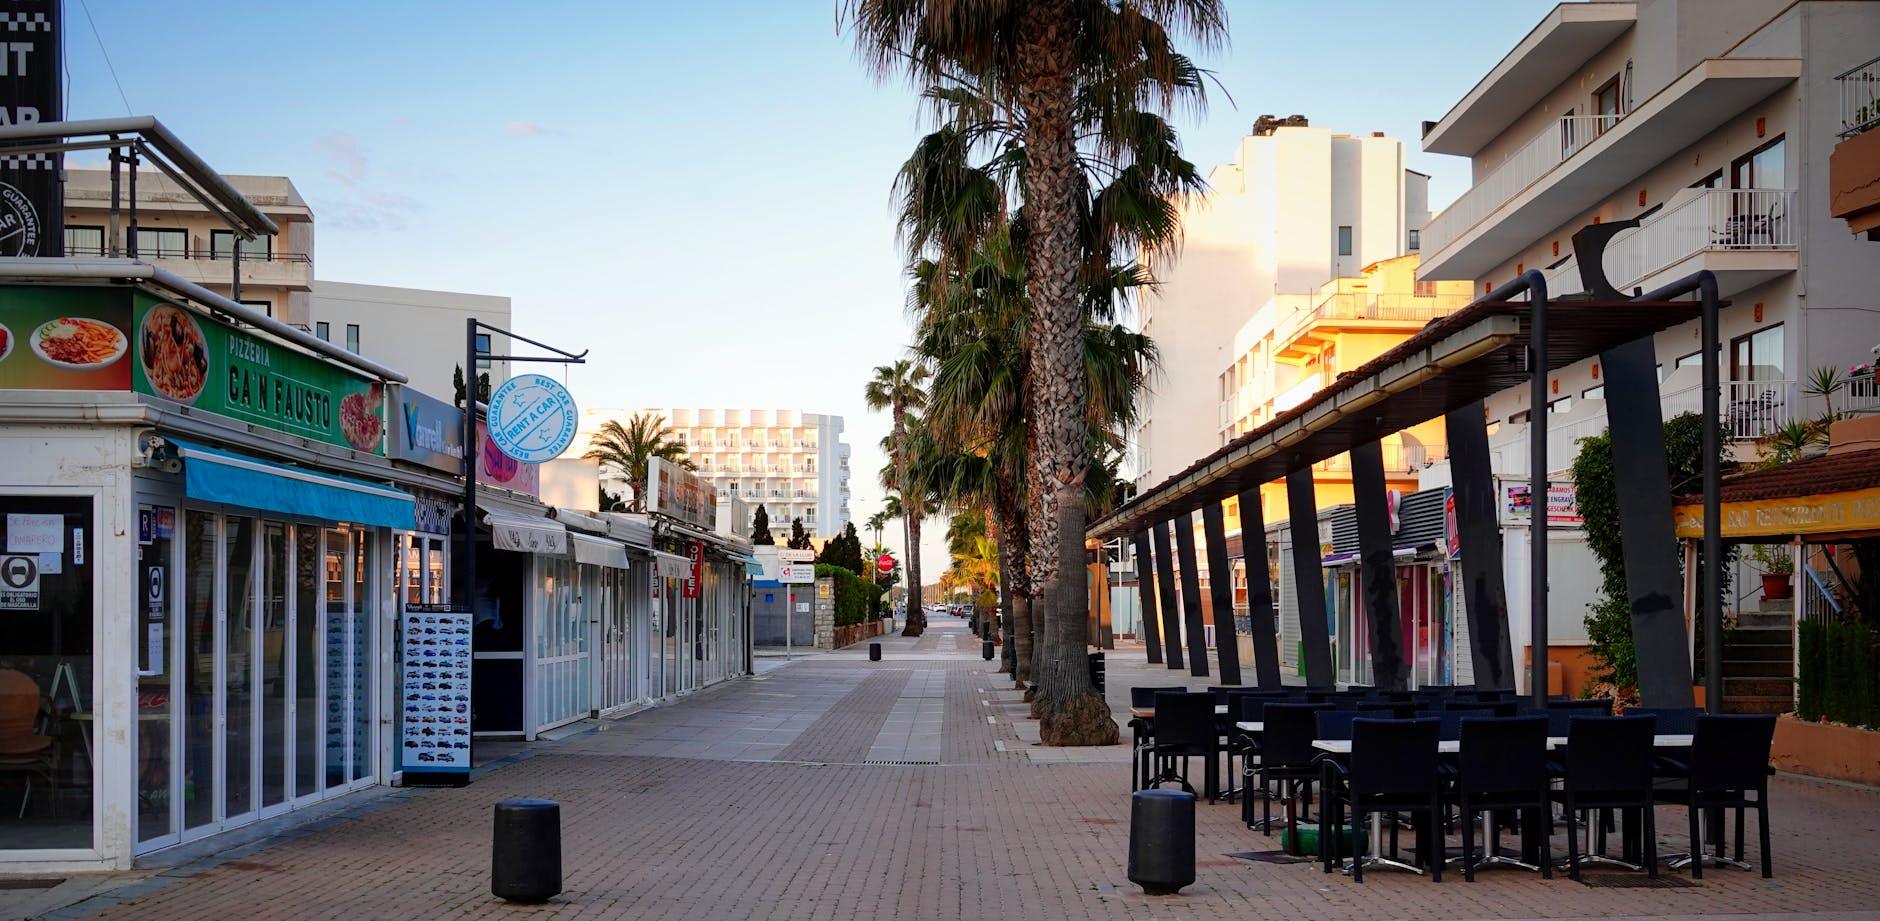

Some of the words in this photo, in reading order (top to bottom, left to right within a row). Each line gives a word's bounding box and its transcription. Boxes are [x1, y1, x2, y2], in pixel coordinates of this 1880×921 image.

[3, 189, 36, 246] GUARANTEE
[229, 335, 270, 367] PIZZERIA
[535, 378, 555, 390] BEST
[557, 391, 570, 405] CAR
[274, 379, 330, 429] FAUSTO
[491, 382, 517, 427] GUARANTEE
[507, 417, 531, 440] RENT
[529, 412, 539, 422] A
[536, 397, 556, 415] CAR
[494, 431, 507, 446] CAR
[549, 410, 574, 455] GUARANTEE
[508, 447, 529, 459] BEST
[142, 514, 149, 532] R
[687, 545, 699, 596] OUTLET
